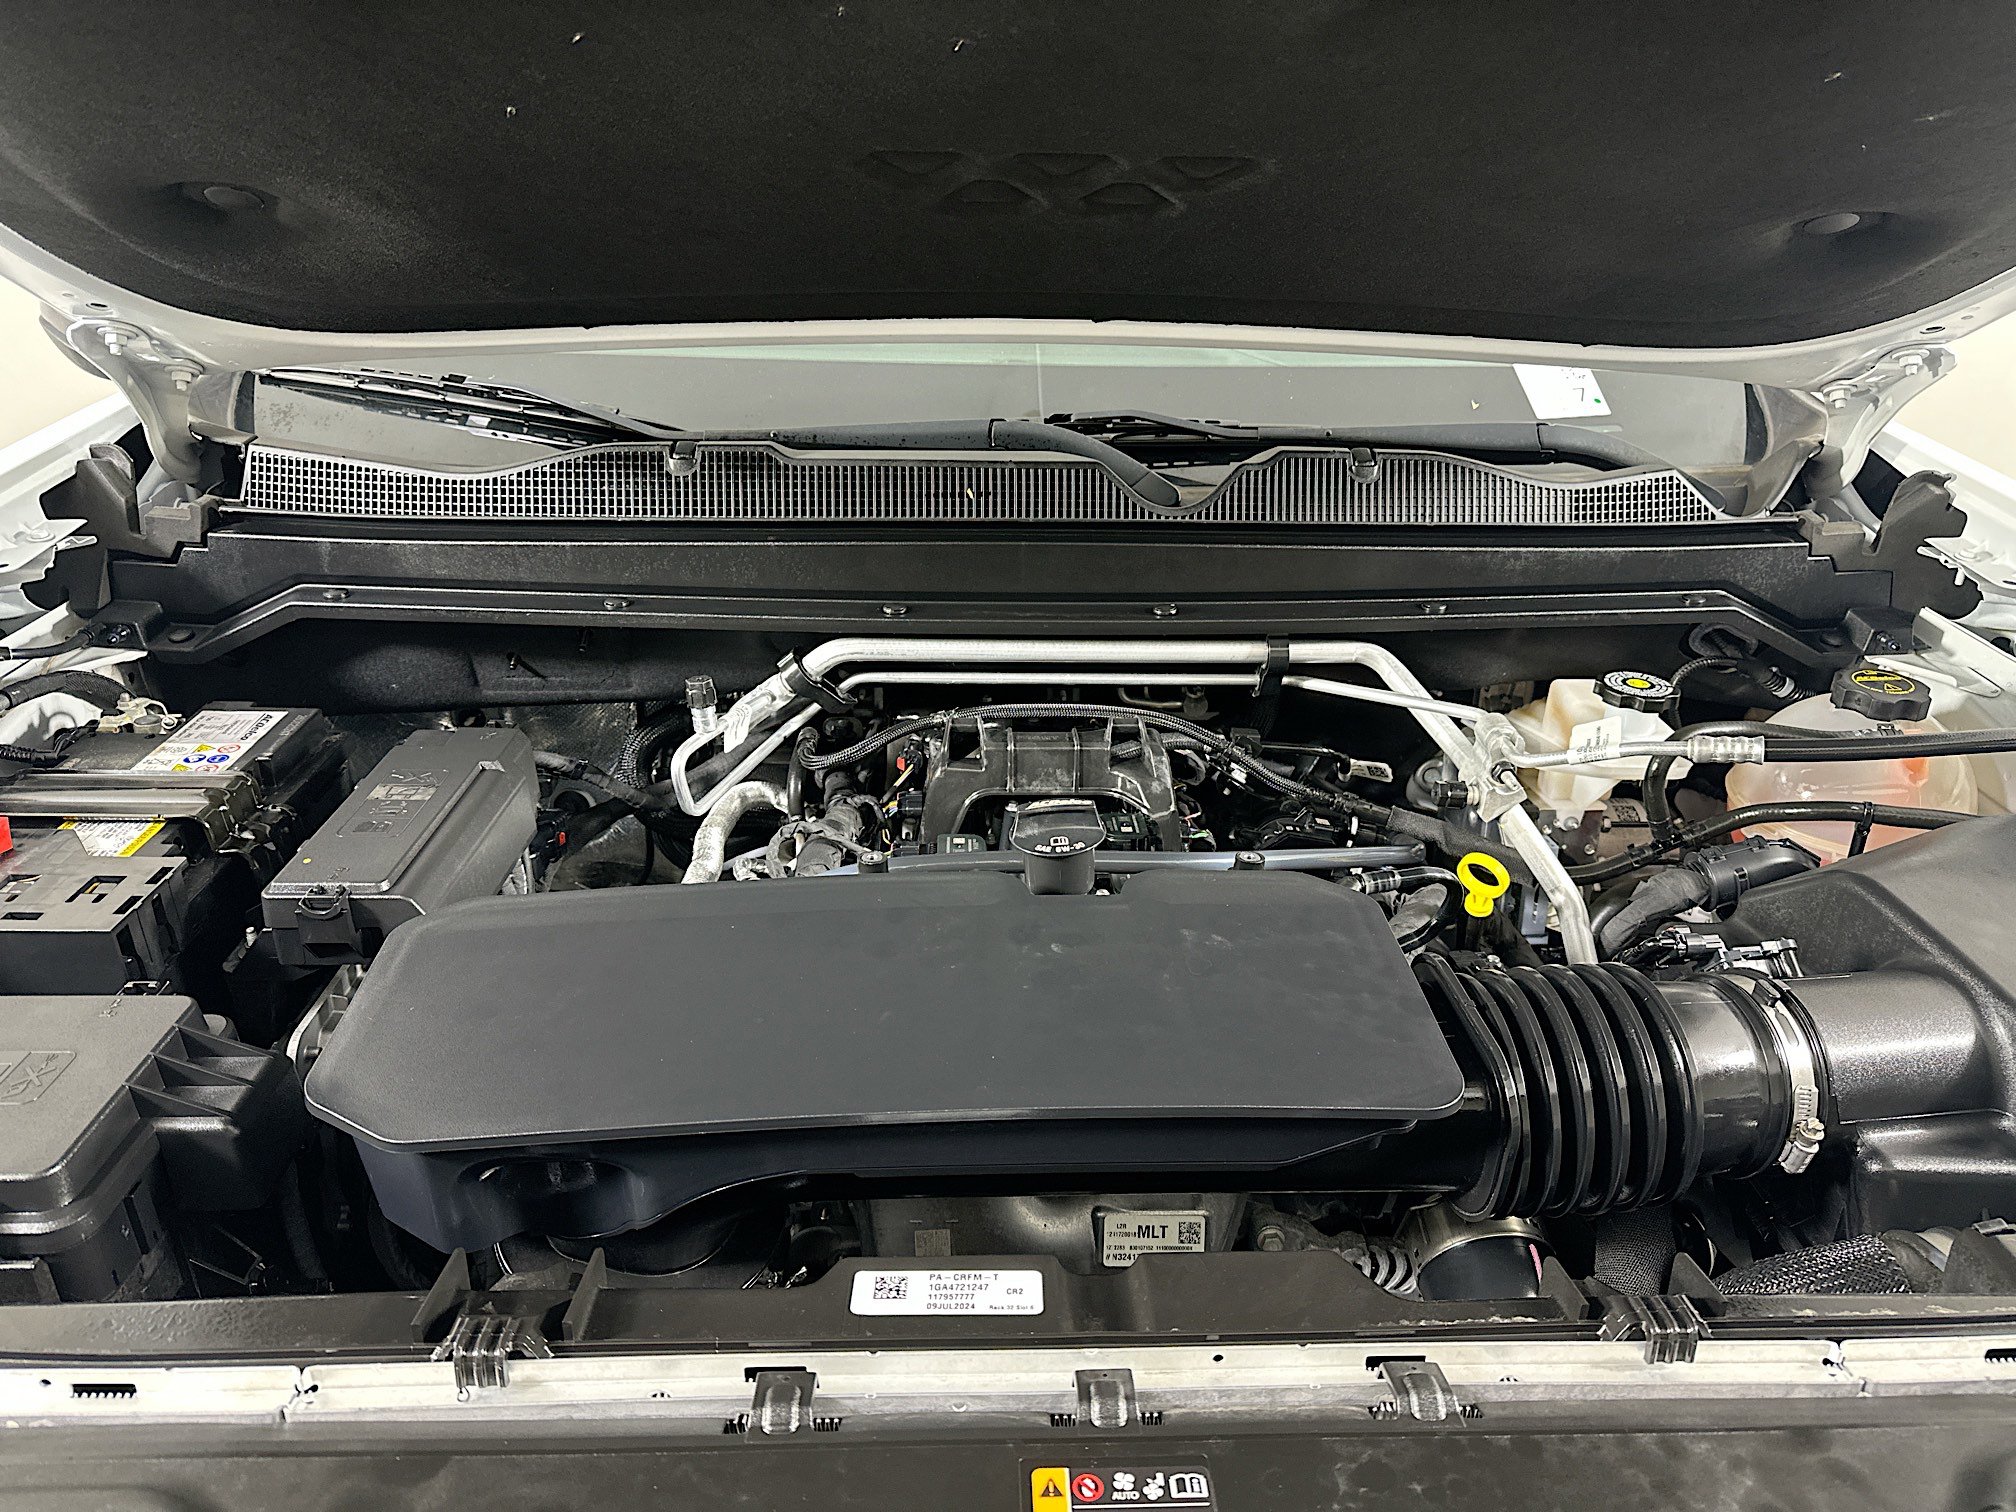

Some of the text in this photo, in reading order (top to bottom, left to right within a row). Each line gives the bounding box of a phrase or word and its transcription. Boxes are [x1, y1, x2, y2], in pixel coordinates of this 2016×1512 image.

[240, 713, 273, 741] ACDelco
[1034, 844, 1052, 853] SAE
[1137, 1224, 1169, 1239] MLT
[929, 1283, 989, 1291] 1GA4721247
[928, 1293, 975, 1301] 117957777
[1111, 1491, 1140, 1501] AUTO
